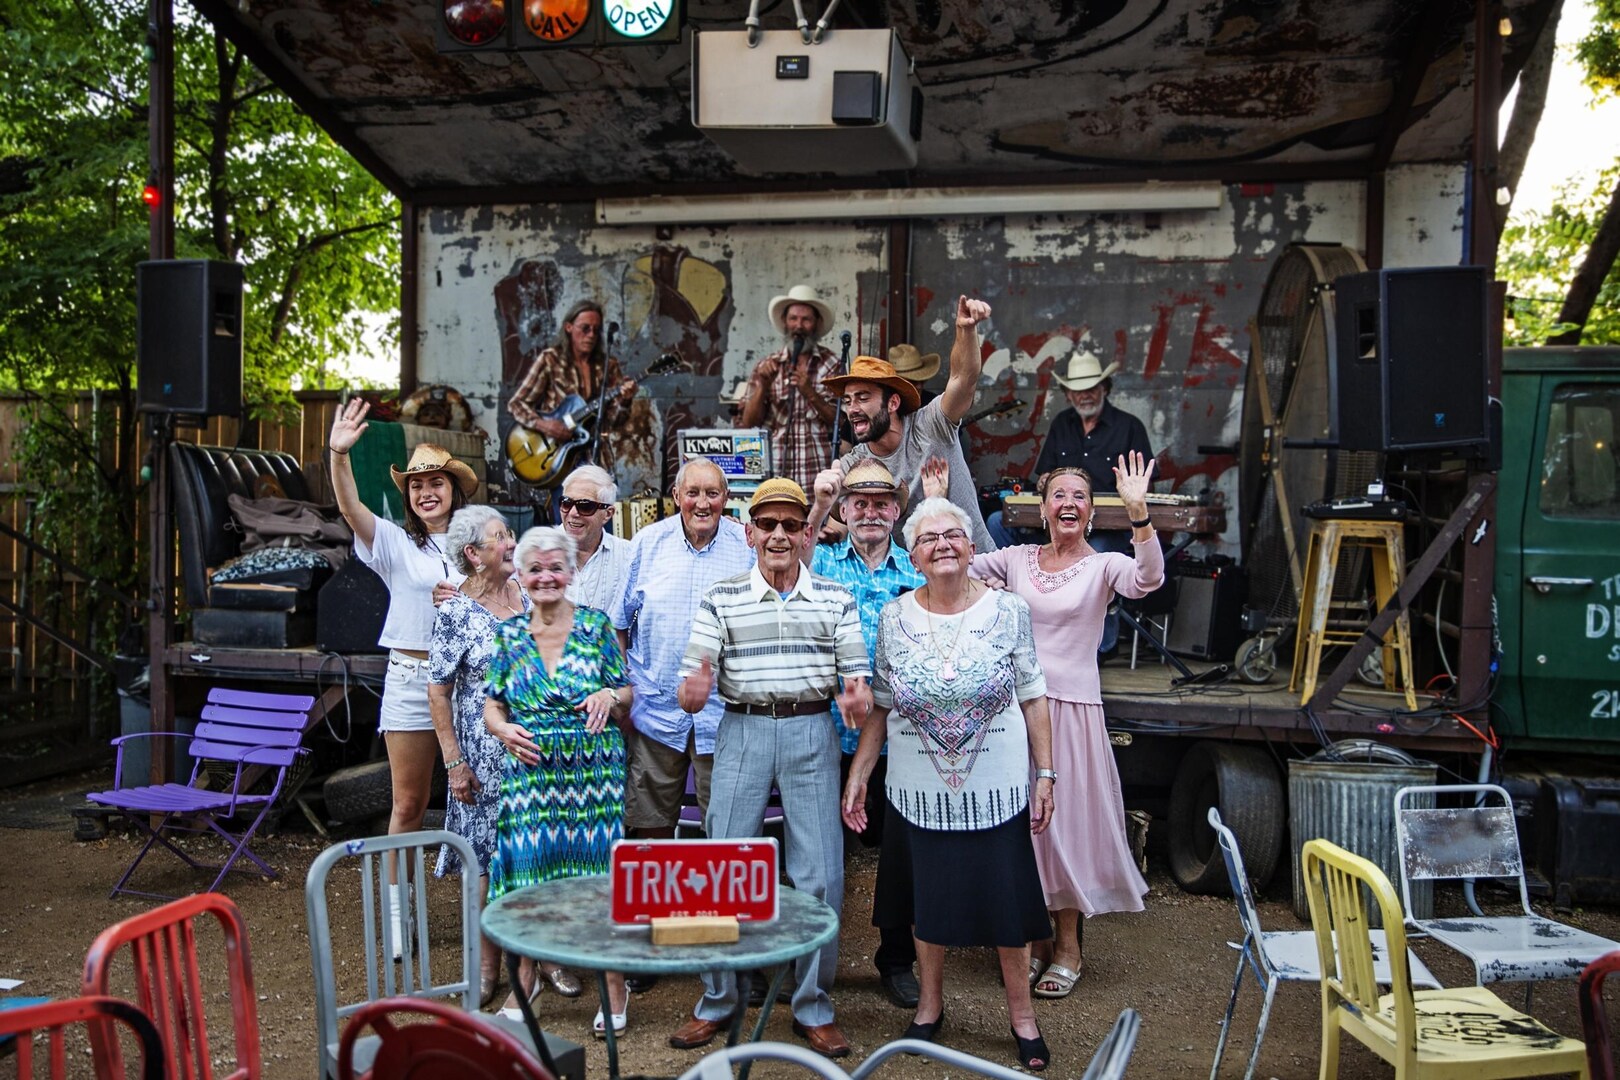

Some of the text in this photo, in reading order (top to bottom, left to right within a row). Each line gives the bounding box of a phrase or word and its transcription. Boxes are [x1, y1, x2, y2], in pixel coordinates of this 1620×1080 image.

[529, 12, 579, 38] CALL
[609, 1, 666, 31] OPEN
[620, 859, 769, 904] TRK YRD
